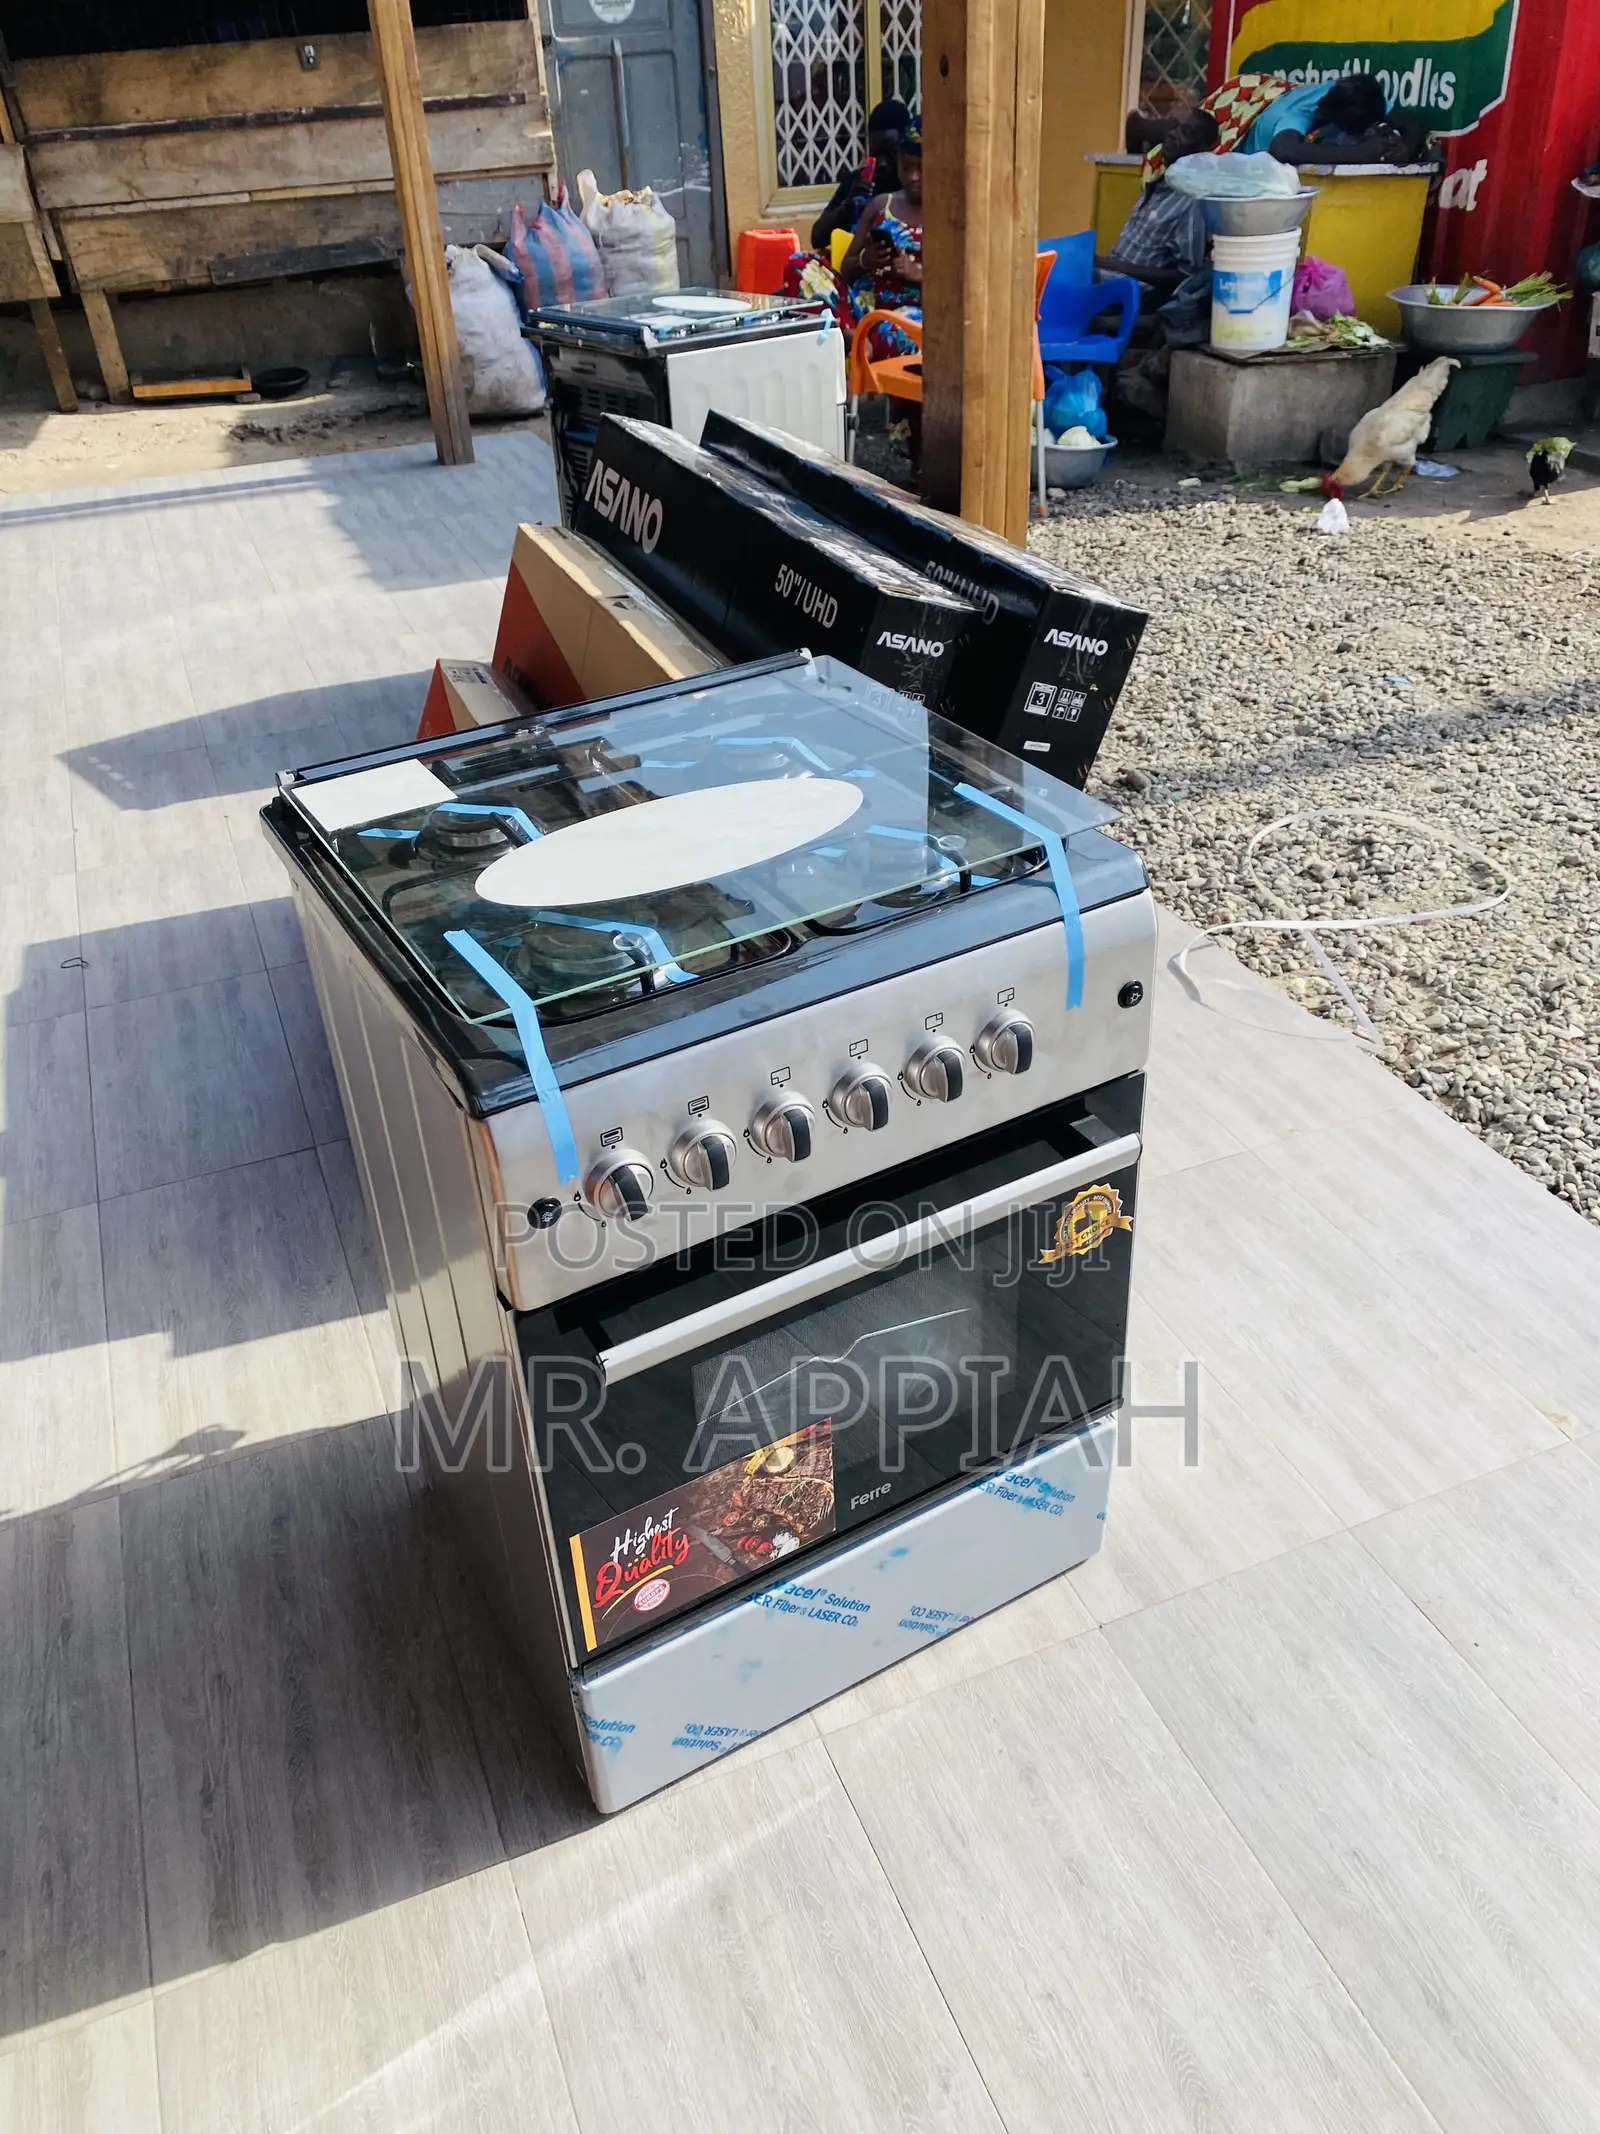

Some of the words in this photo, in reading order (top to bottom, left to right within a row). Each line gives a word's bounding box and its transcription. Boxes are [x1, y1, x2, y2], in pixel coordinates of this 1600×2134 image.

[584, 459, 663, 554] ASANO
[774, 563, 839, 630] 50"/UHD
[876, 631, 945, 657] ASANO
[1043, 628, 1109, 656] ASANO
[1080, 1218, 1110, 1240] CHOICE
[850, 1482, 892, 1510] Ferre
[610, 1507, 679, 1564] Highest
[593, 1527, 690, 1609] Quality
[772, 1598, 800, 1614] Fiber
[807, 1606, 840, 1622] LASER
[824, 1592, 872, 1613] Solution
